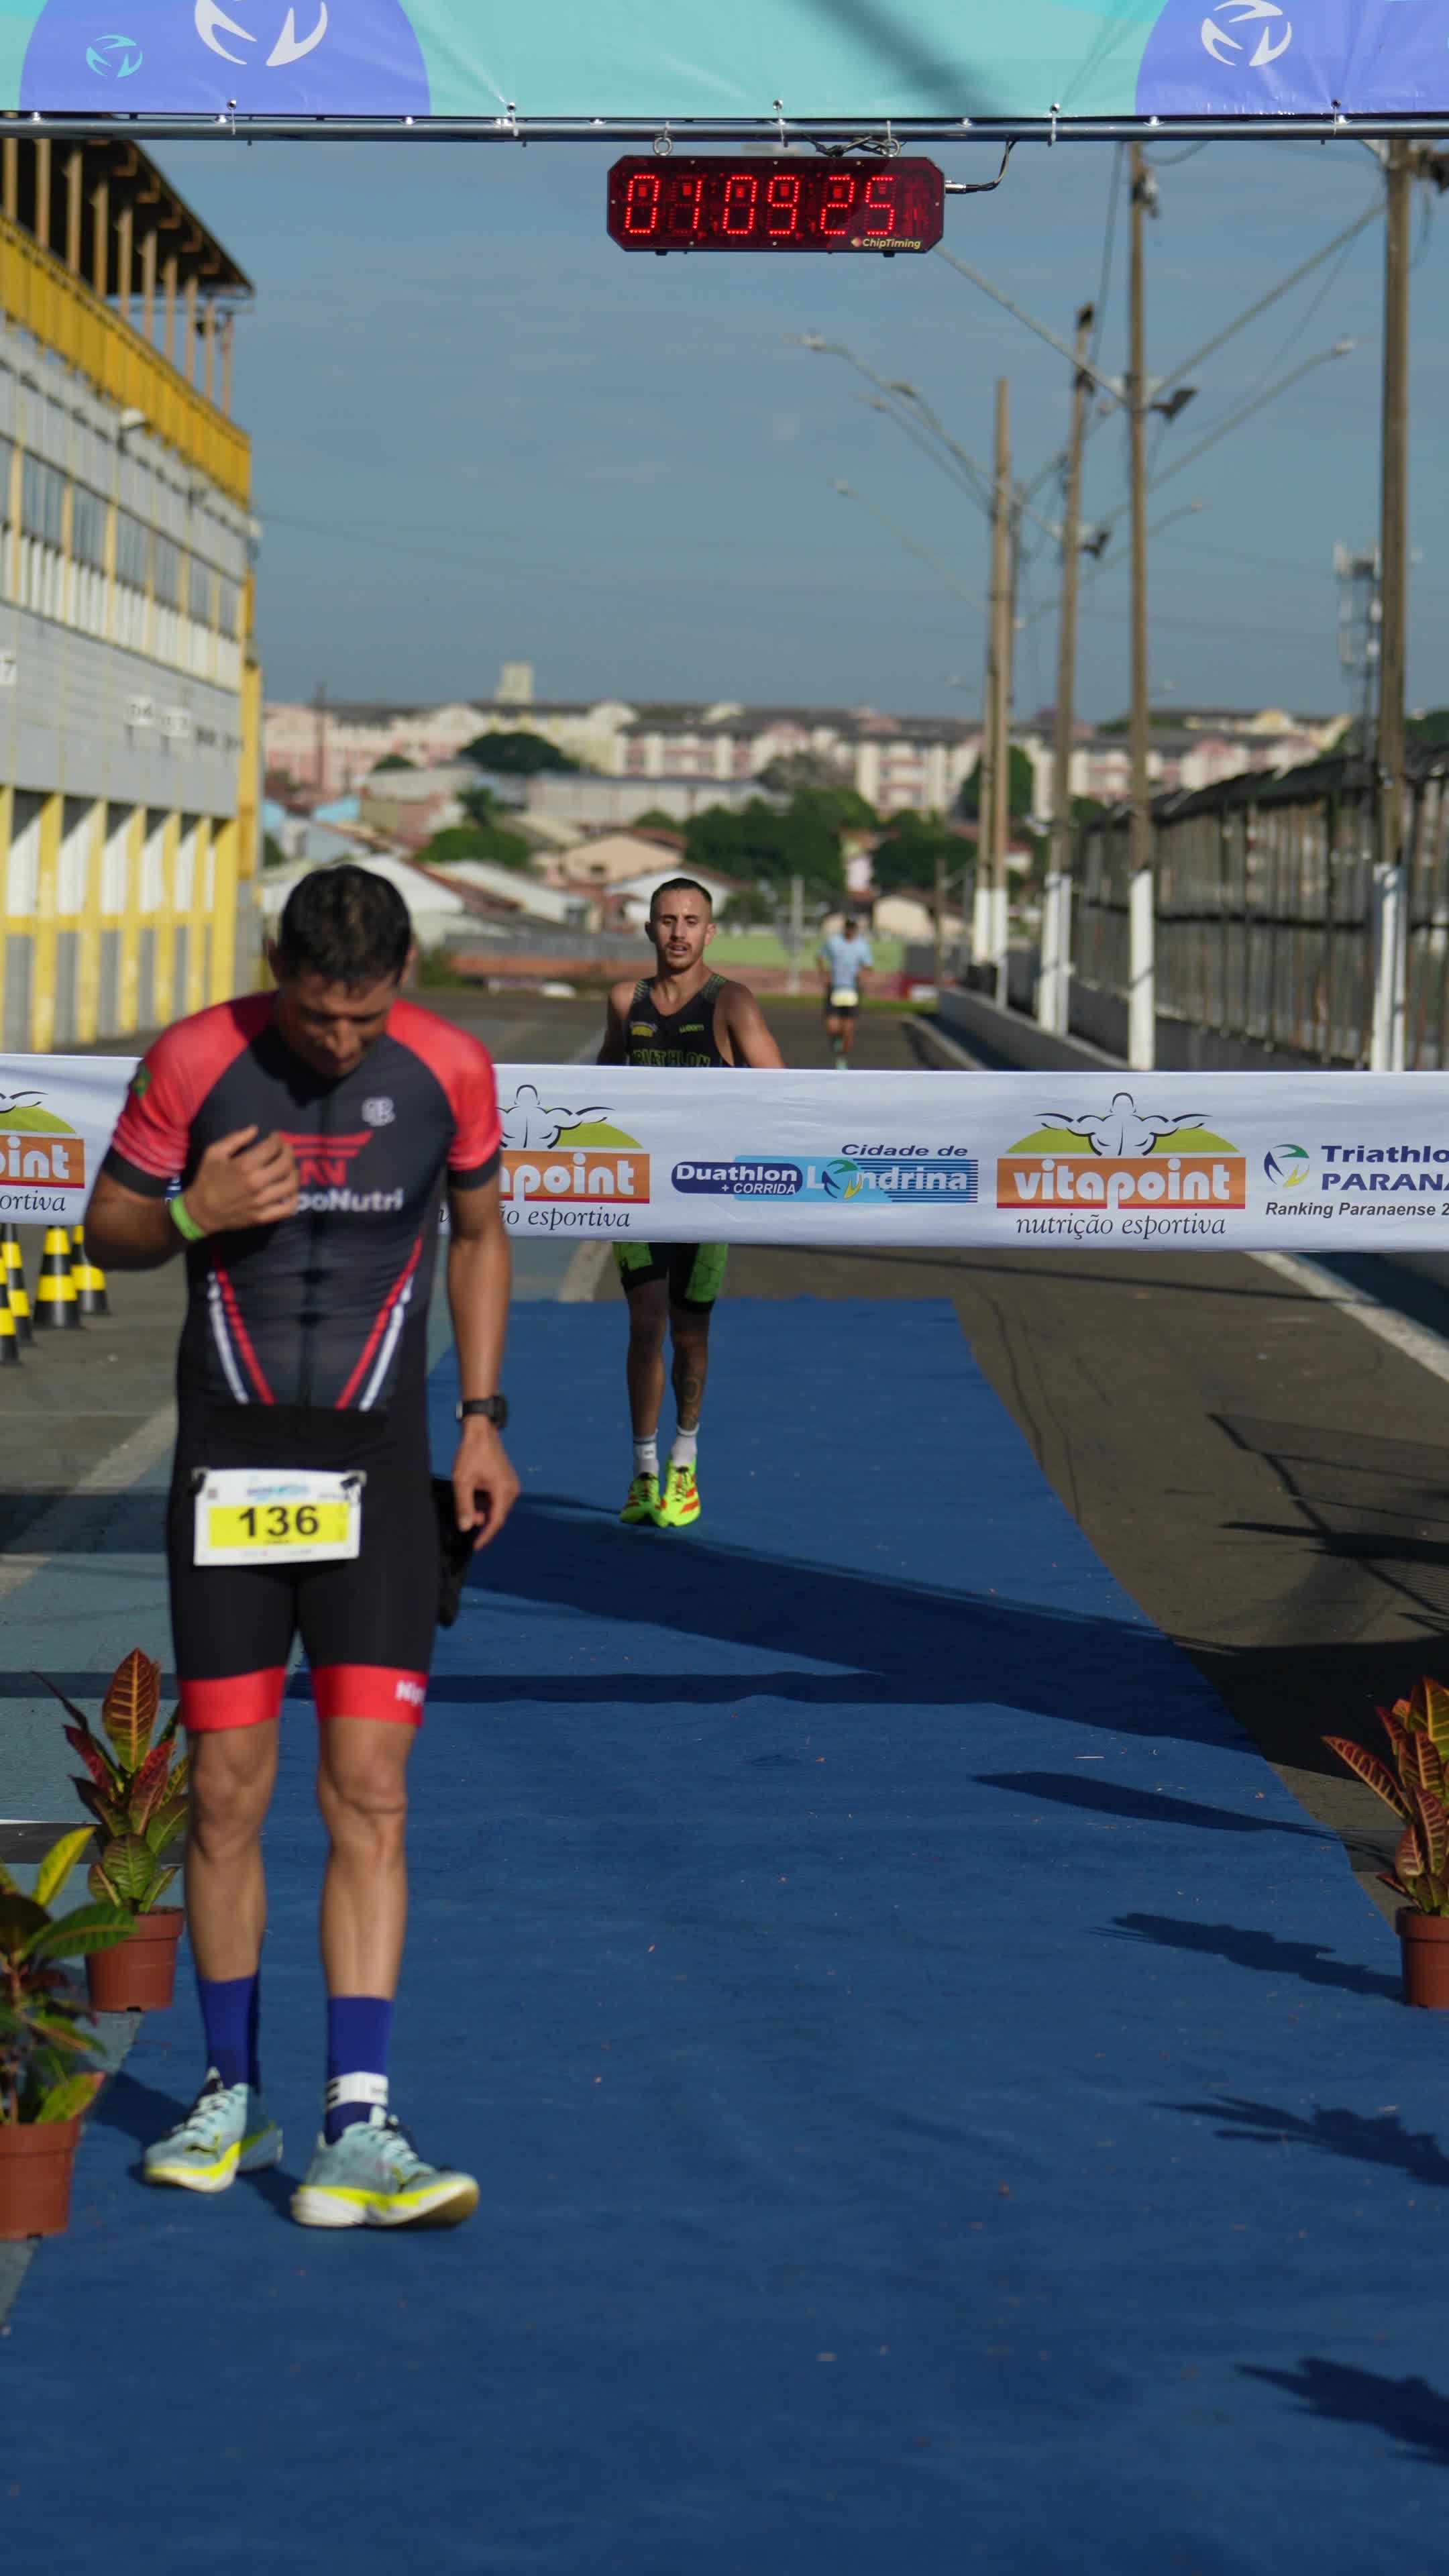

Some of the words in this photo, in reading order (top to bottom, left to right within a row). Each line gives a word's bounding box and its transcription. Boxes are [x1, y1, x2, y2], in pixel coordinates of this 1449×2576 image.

[862, 237, 922, 250] ChipTiming
[841, 1144, 929, 1157] Cidade
[937, 1145, 968, 1157] de
[676, 1165, 797, 1181] Duathlon
[733, 1183, 796, 1195] CORRIDA
[1014, 1158, 1230, 1209] vitapoint
[528, 1206, 631, 1230] esportiva
[1265, 1202, 1334, 1218] Ranking
[1338, 1202, 1436, 1216] Paranaense
[1016, 1213, 1113, 1240] nutrição
[1122, 1213, 1226, 1240] esportiva
[239, 1505, 319, 1537] 136
